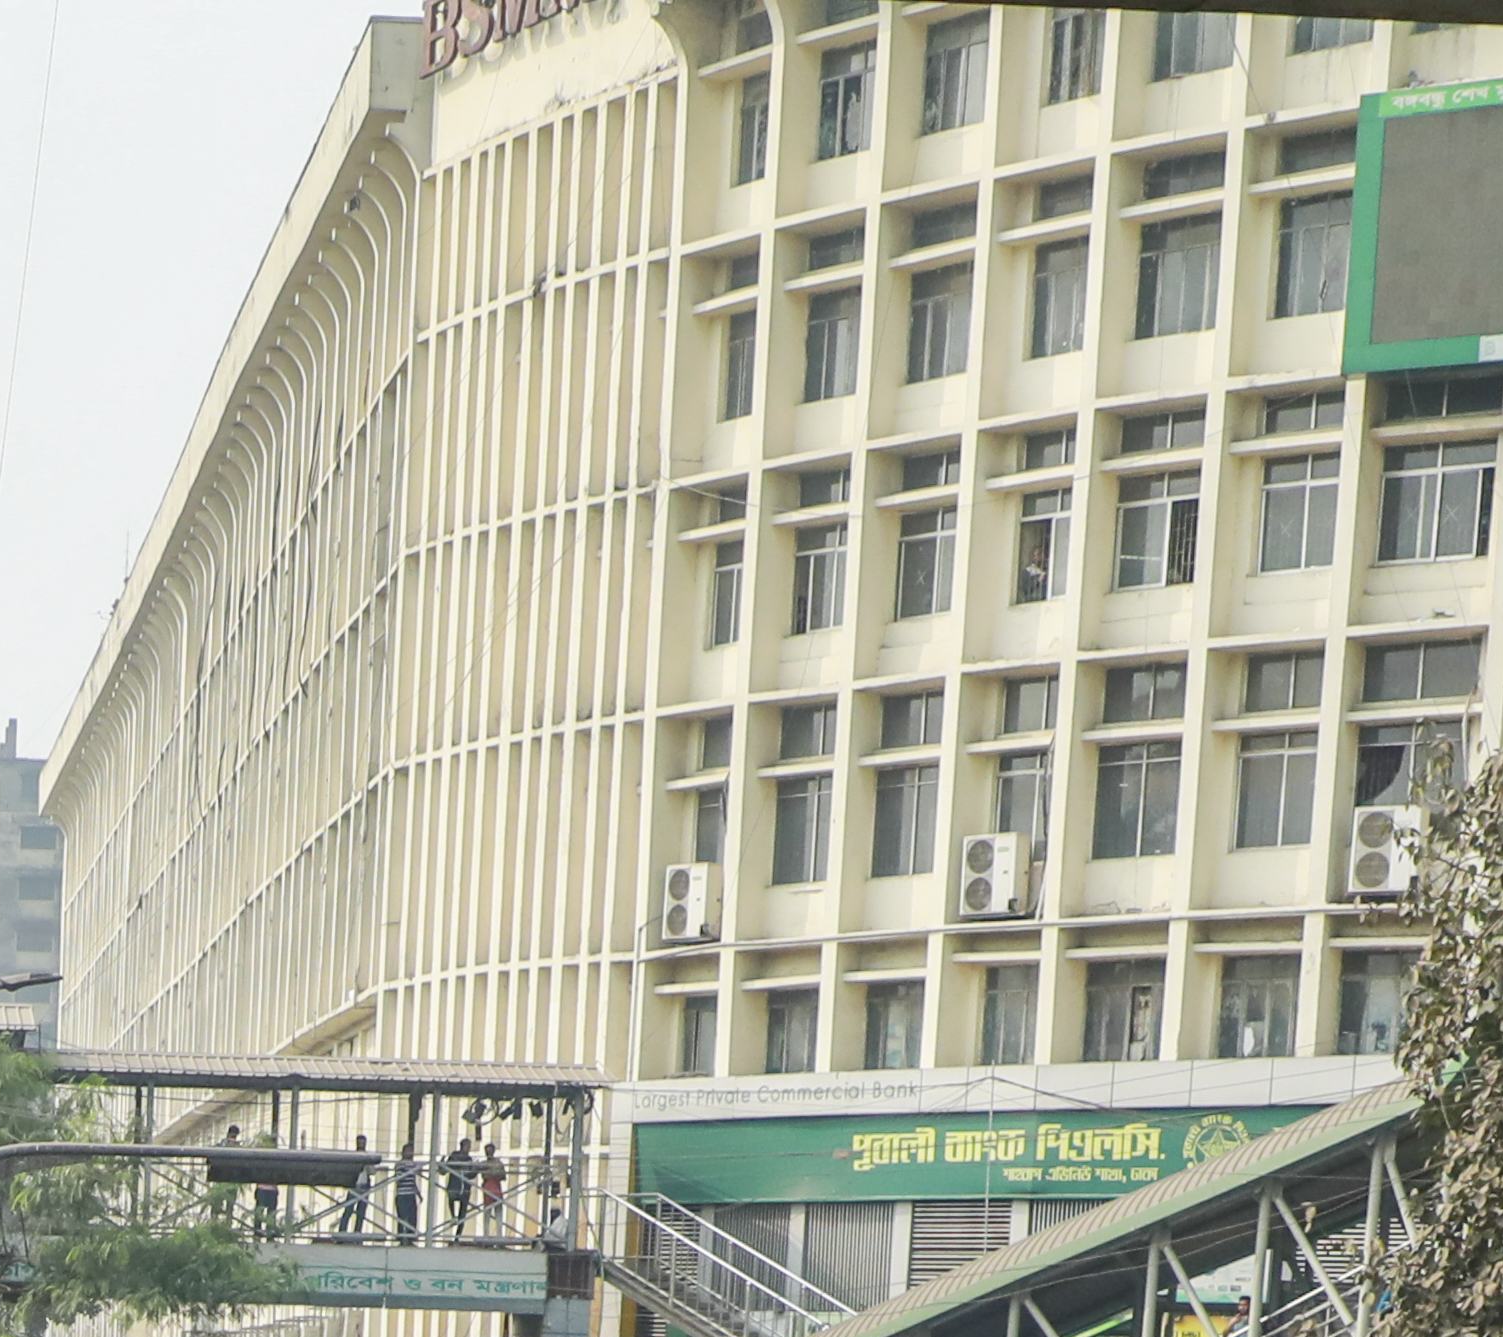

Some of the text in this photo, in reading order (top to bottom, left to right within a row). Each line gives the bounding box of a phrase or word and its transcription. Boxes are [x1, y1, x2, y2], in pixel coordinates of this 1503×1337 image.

[1452, 85, 1490, 103] শেখ
[634, 1080, 918, 1111] Largest Private Commercial Bank
[1130, 1166, 1159, 1182] ঢাকা
[403, 1272, 422, 1291] ও
[431, 1273, 464, 1291] বন
